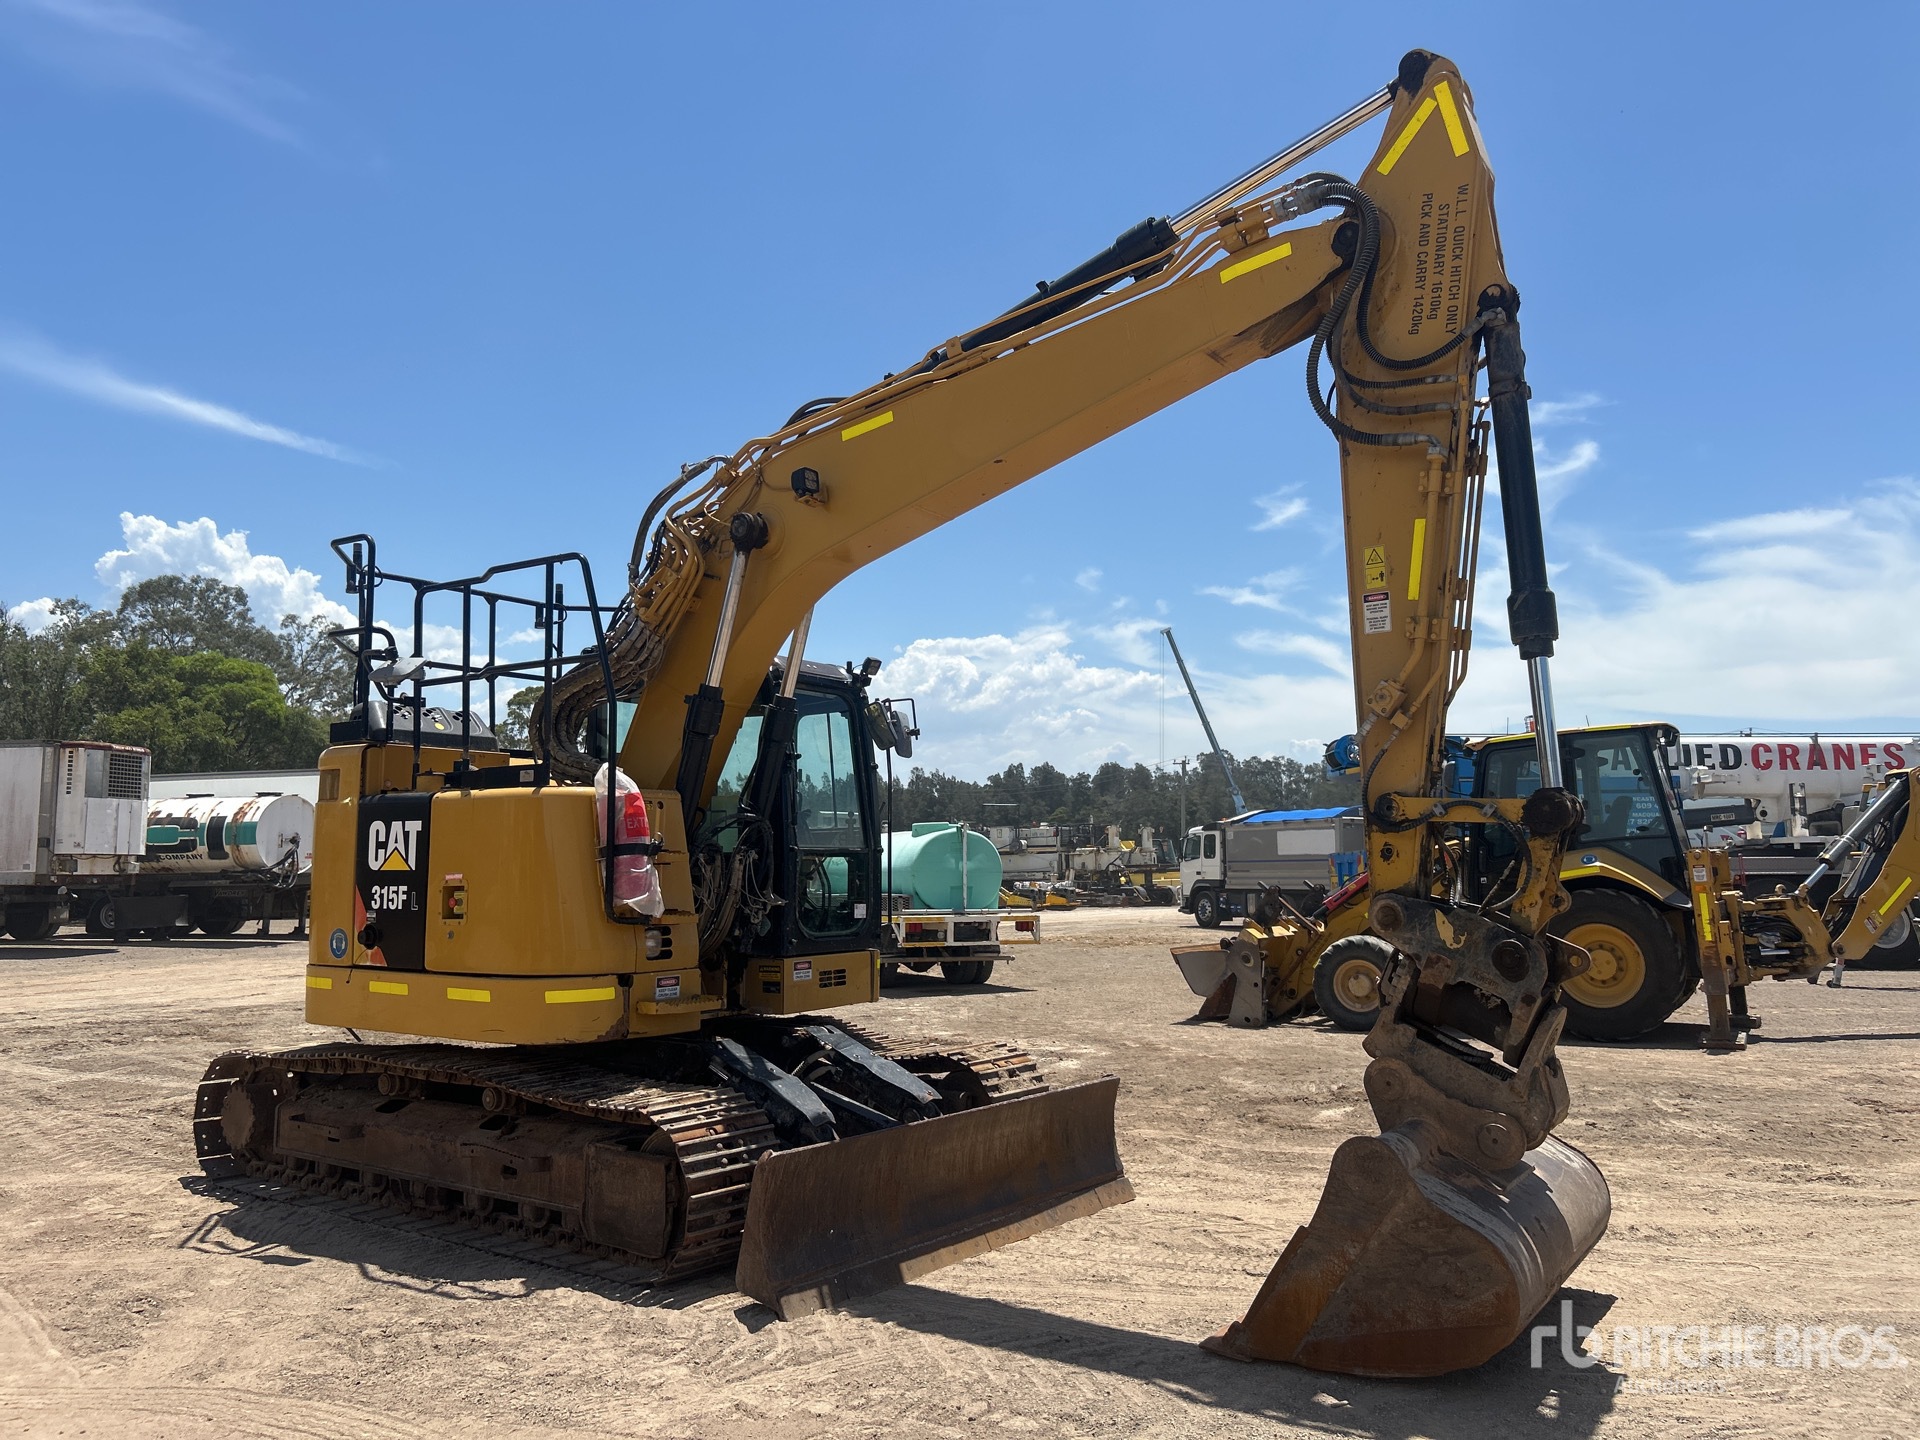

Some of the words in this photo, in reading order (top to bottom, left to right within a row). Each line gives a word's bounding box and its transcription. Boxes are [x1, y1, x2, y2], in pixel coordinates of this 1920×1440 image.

[1420, 193, 1433, 219] PICK
[1455, 184, 1469, 221] W.L.L.
[1418, 223, 1431, 247] AND
[1433, 203, 1450, 276] STATIONARY
[1452, 226, 1465, 261] QUICK
[1414, 251, 1428, 291] CARRY
[1448, 266, 1462, 301] HITCH
[1408, 296, 1424, 336] 1420kg
[1427, 282, 1443, 320] 1610kg
[1445, 305, 1458, 335] ONLY
[1751, 743, 1906, 771] CRANES
[368, 820, 422, 871] CAT
[371, 885, 408, 910] 315F
[411, 891, 418, 910] L
